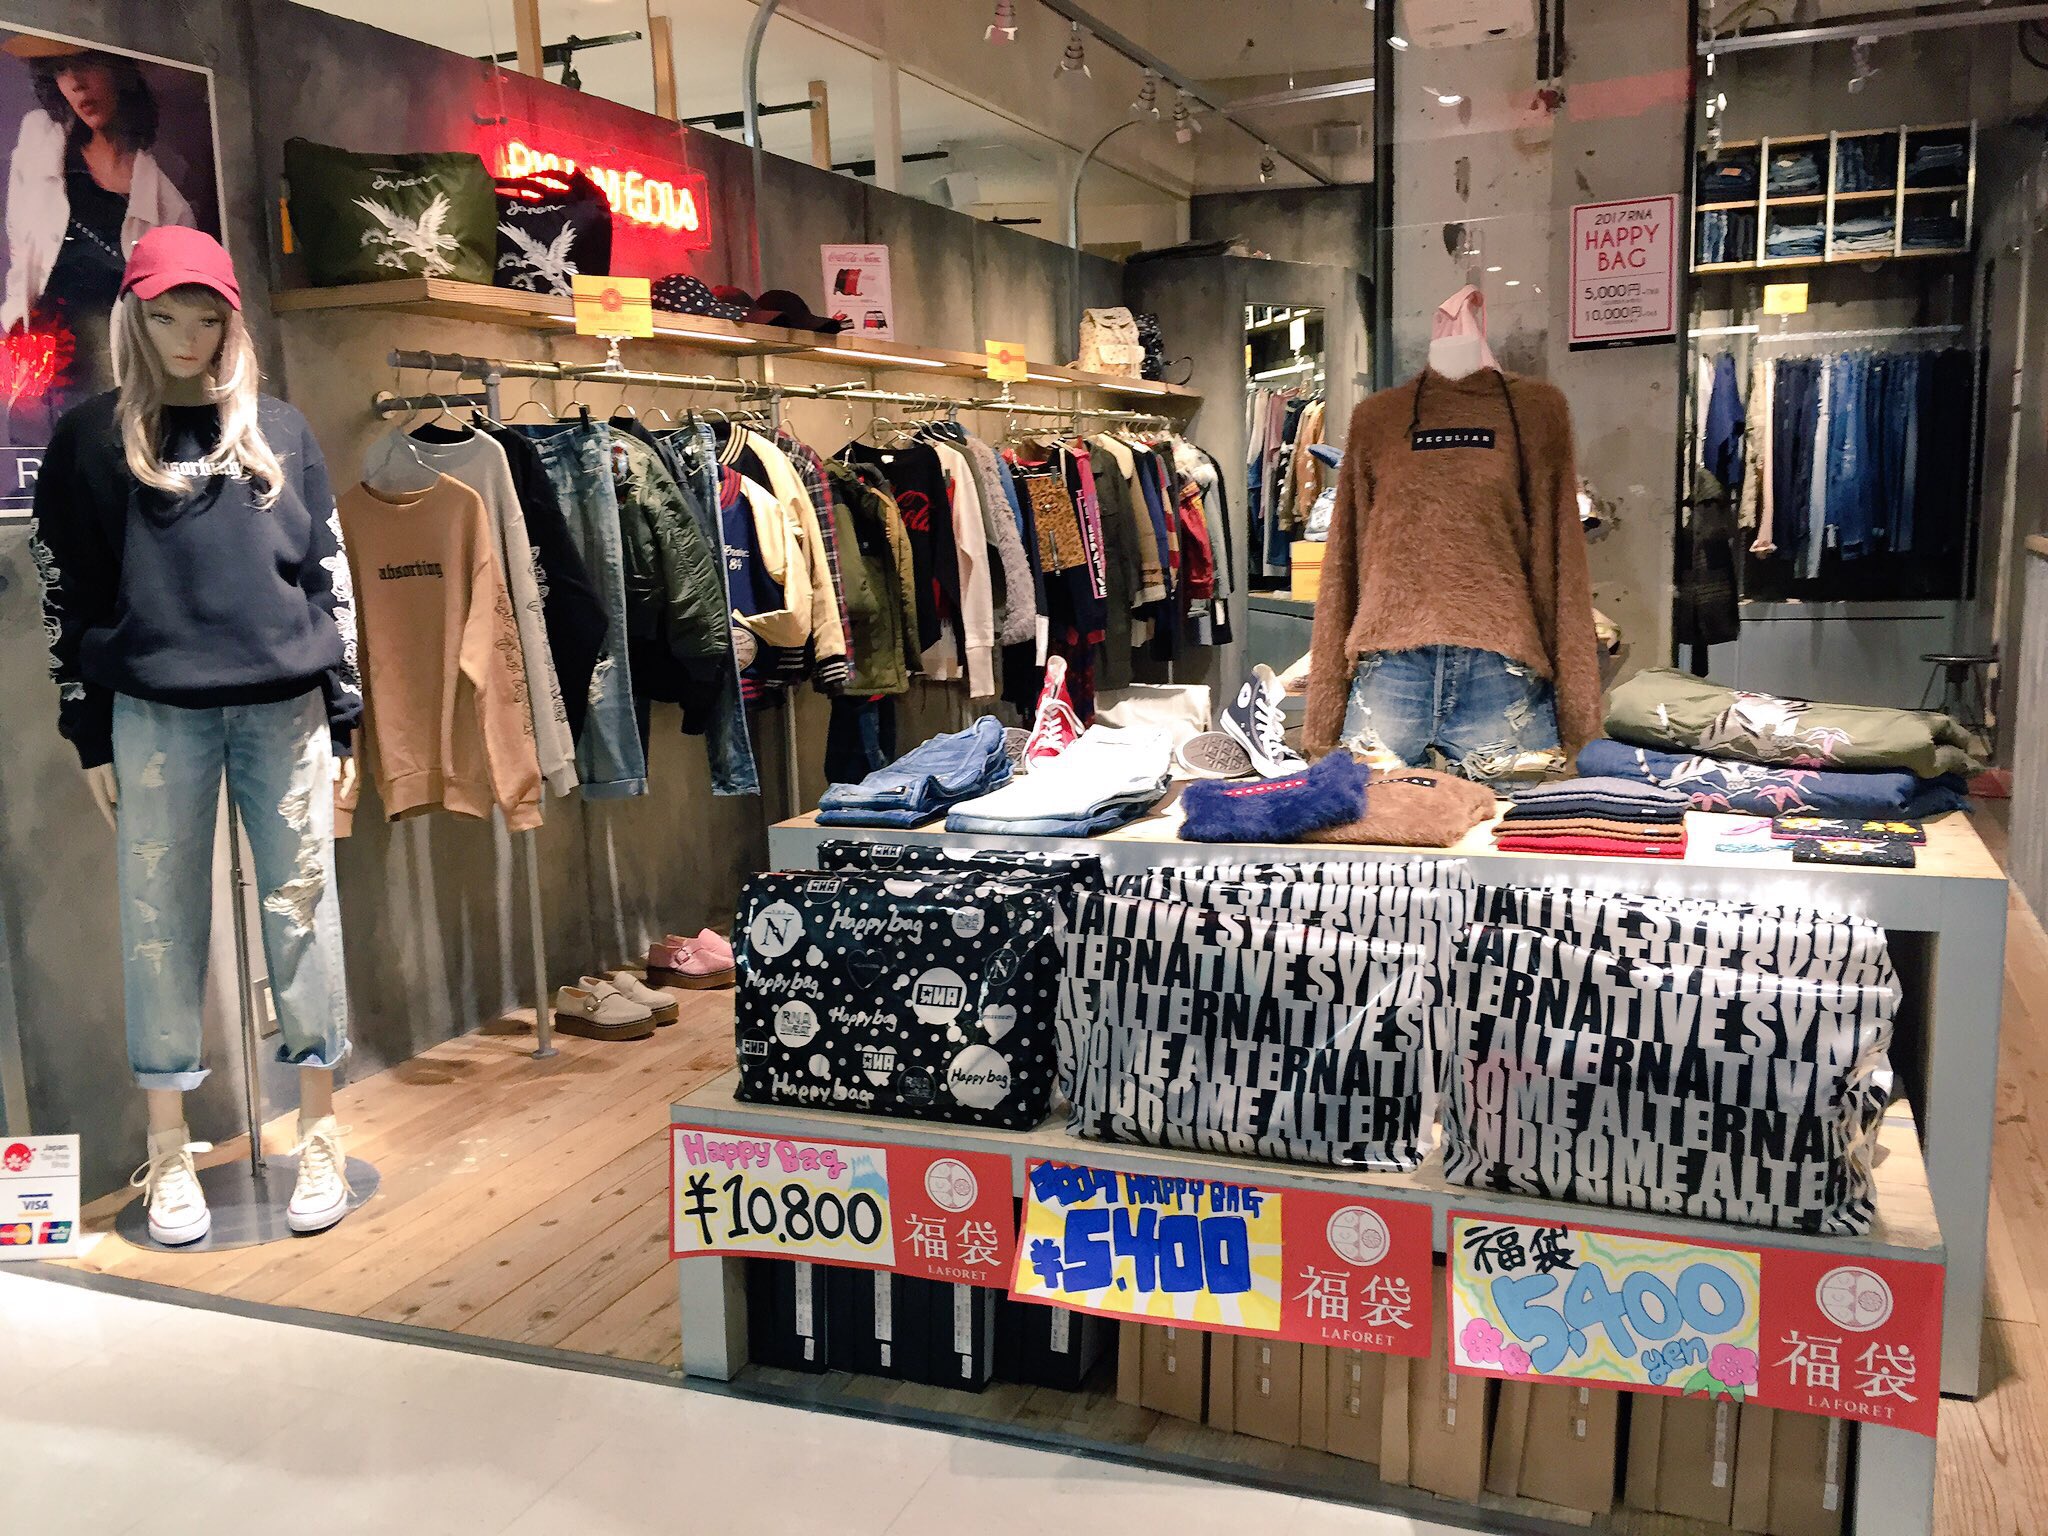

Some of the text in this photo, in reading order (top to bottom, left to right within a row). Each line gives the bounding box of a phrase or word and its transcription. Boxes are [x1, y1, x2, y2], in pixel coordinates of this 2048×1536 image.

[1584, 223, 1660, 251] HAPPY
[1597, 247, 1647, 272] BAG
[1416, 434, 1490, 444] PECULIAR
[683, 1133, 848, 1180] Happy Bag
[22, 1200, 49, 1211] VISA
[1124, 1169, 1205, 1214] HAPPY
[1210, 1181, 1264, 1219] BAG
[901, 1213, 1002, 1267] 福袋
[1463, 1224, 1580, 1275] 福袋
[927, 1264, 987, 1281] LAFORET
[1292, 1264, 1414, 1330] 福袋
[1321, 1326, 1396, 1347] LAFORET
[1640, 1335, 1709, 1386] yen
[1770, 1329, 1919, 1404] 福袋
[1807, 1394, 1896, 1420] LAFORET
